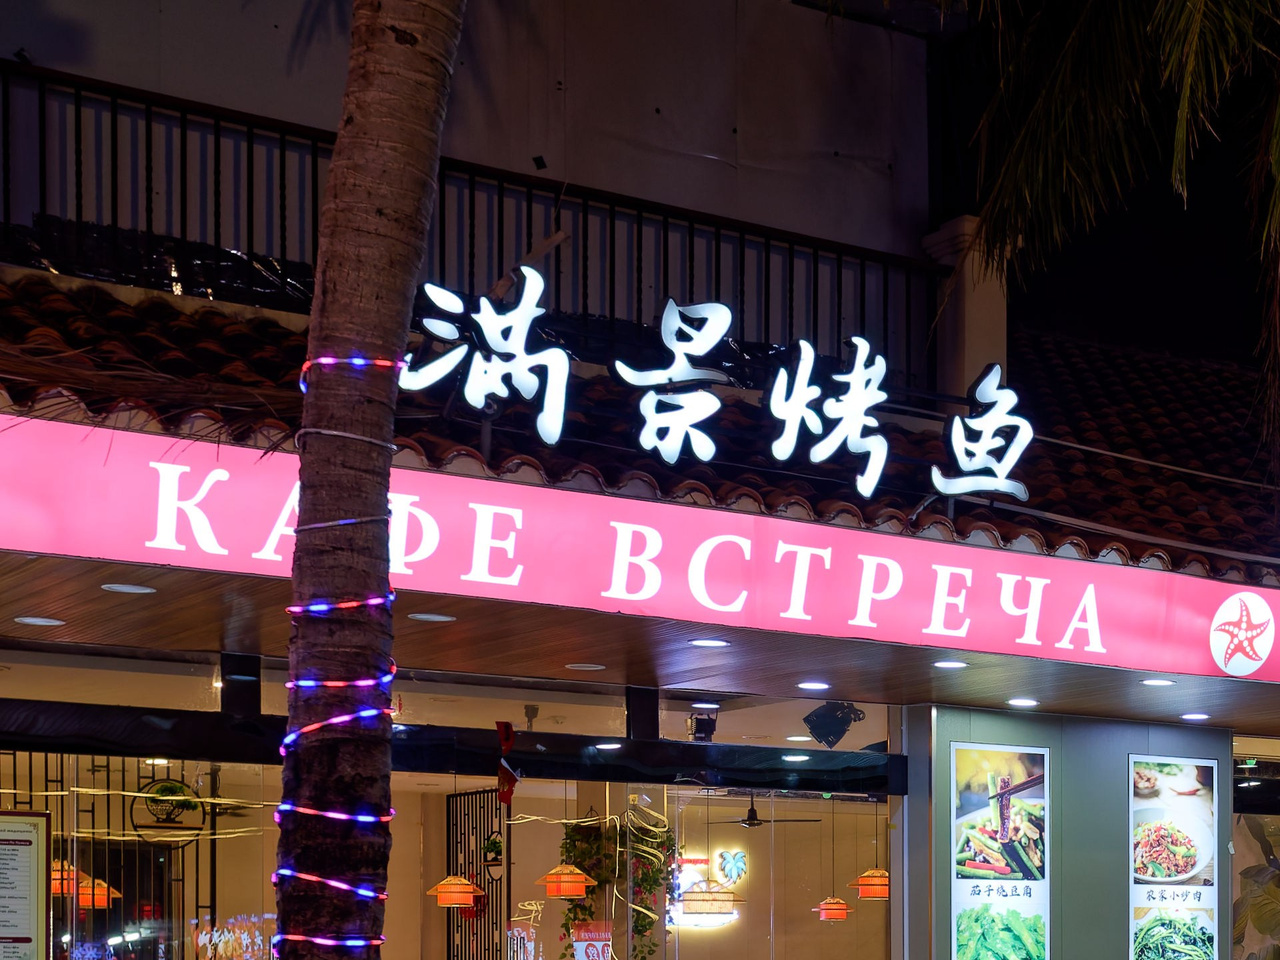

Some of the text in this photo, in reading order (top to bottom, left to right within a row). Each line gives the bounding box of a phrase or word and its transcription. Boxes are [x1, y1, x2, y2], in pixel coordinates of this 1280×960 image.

[398, 265, 1034, 500] 满景烤鱼
[601, 521, 1107, 653] ВСТРЕЧА
[1146, 889, 1202, 902] 农家小炒肉
